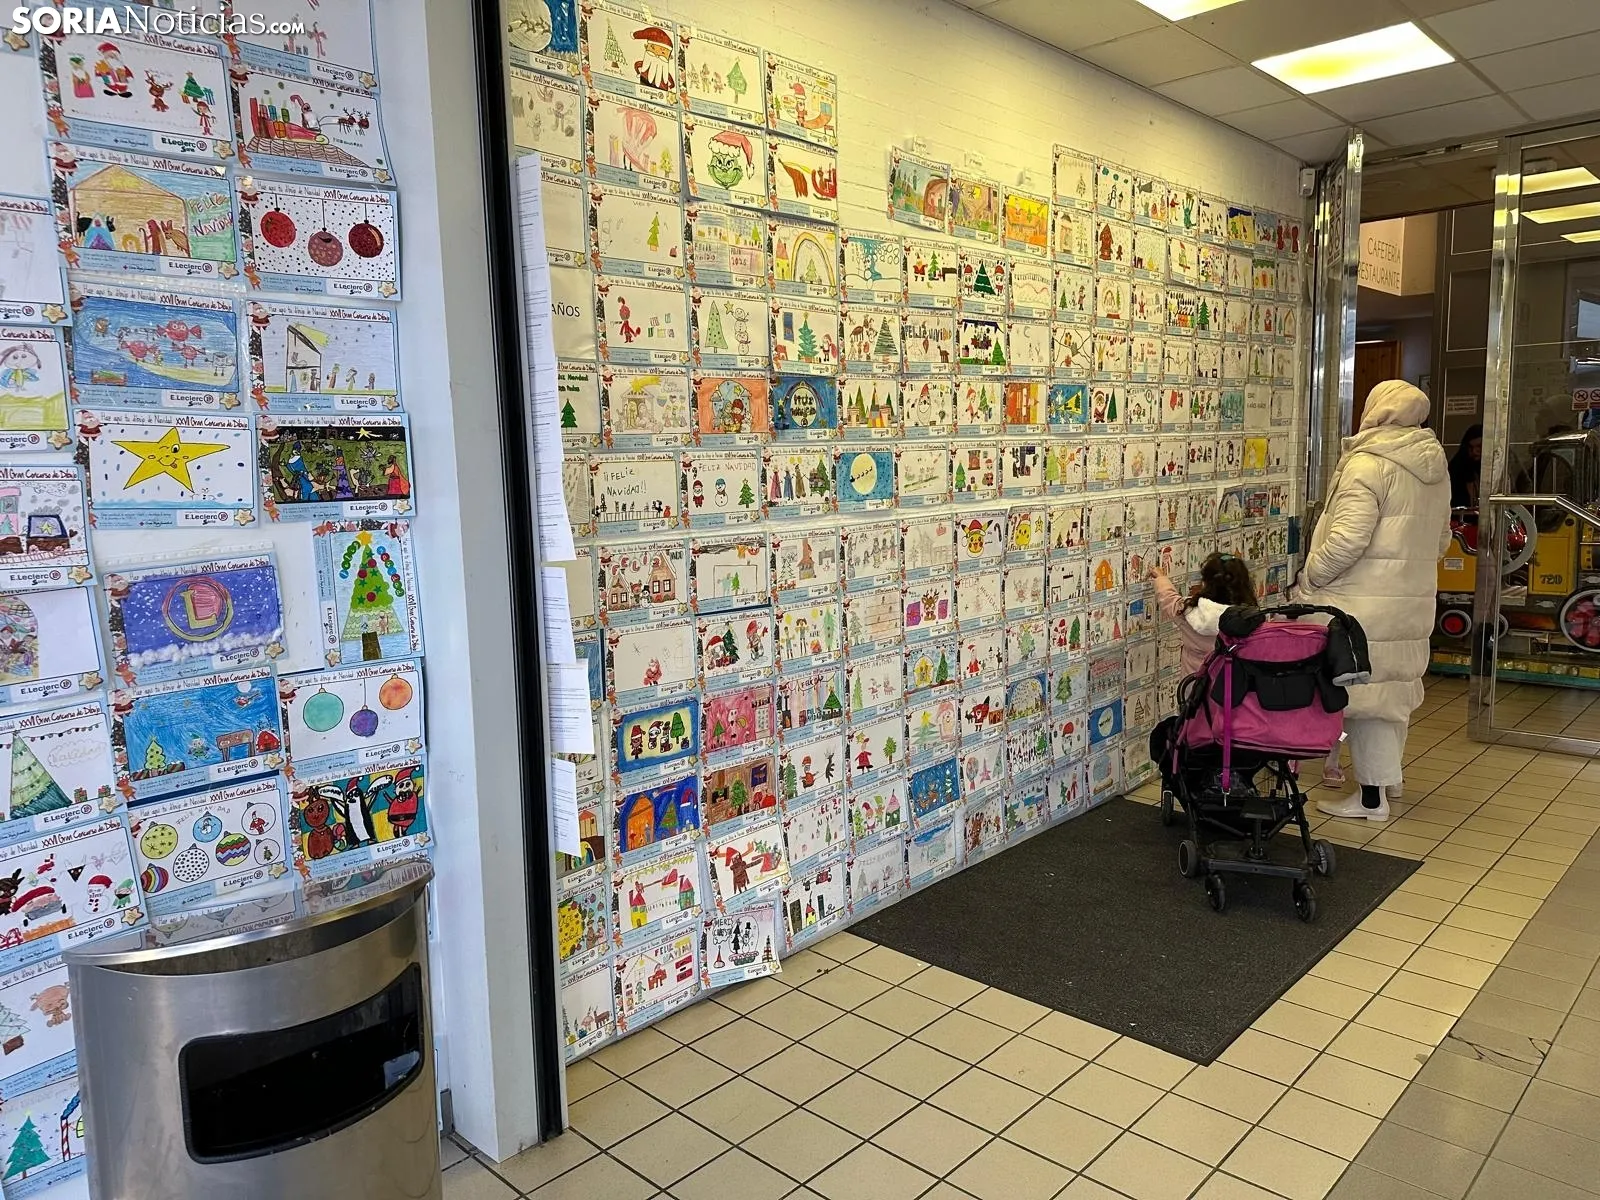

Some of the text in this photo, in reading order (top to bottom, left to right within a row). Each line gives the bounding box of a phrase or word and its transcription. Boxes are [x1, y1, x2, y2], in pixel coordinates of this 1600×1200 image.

[162, 138, 196, 148] E.Leclerc
[169, 262, 202, 271] E.Leclerc
[188, 298, 210, 308] Concurso
[191, 417, 203, 426] Gran
[204, 418, 225, 427] Concurso
[233, 419, 247, 427] Dibujo
[26, 468, 50, 479] Concurso
[59, 469, 77, 479] Dibujo
[227, 561, 247, 570] Concurso
[218, 675, 230, 684] Gran
[231, 673, 249, 682] Concurso
[21, 683, 59, 694] E.Leclerc
[36, 714, 50, 725] Gran
[51, 712, 75, 721] Concurso
[83, 705, 100, 714] Dibujo
[218, 763, 248, 774] E.Leclerc
[236, 787, 255, 796] Concurso
[262, 782, 275, 791] Dibujo
[44, 810, 80, 823] E.Leclerc
[58, 834, 72, 843] Gran
[73, 830, 97, 838] Concurso
[104, 820, 120, 830] Dibujo
[68, 924, 103, 939] E.Leclerc
